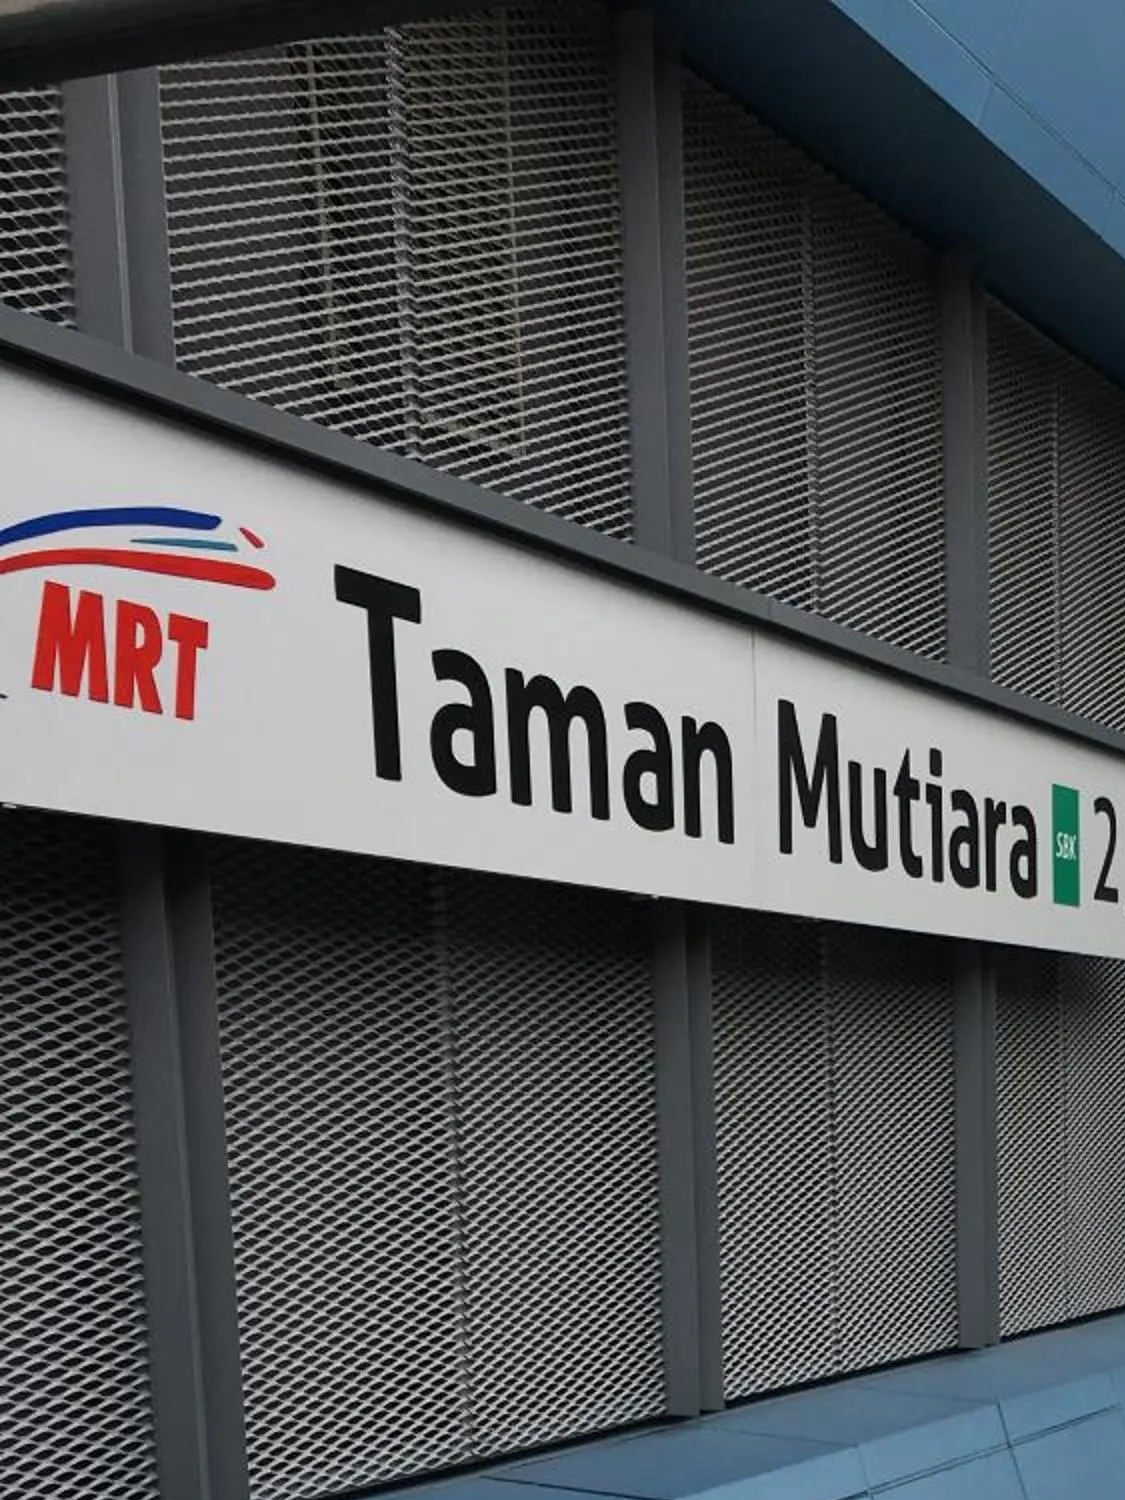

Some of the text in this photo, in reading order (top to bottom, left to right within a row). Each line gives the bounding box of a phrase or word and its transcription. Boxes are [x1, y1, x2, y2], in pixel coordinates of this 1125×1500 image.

[31, 580, 209, 720] MRT
[334, 564, 1038, 899] Taman Mutiara
